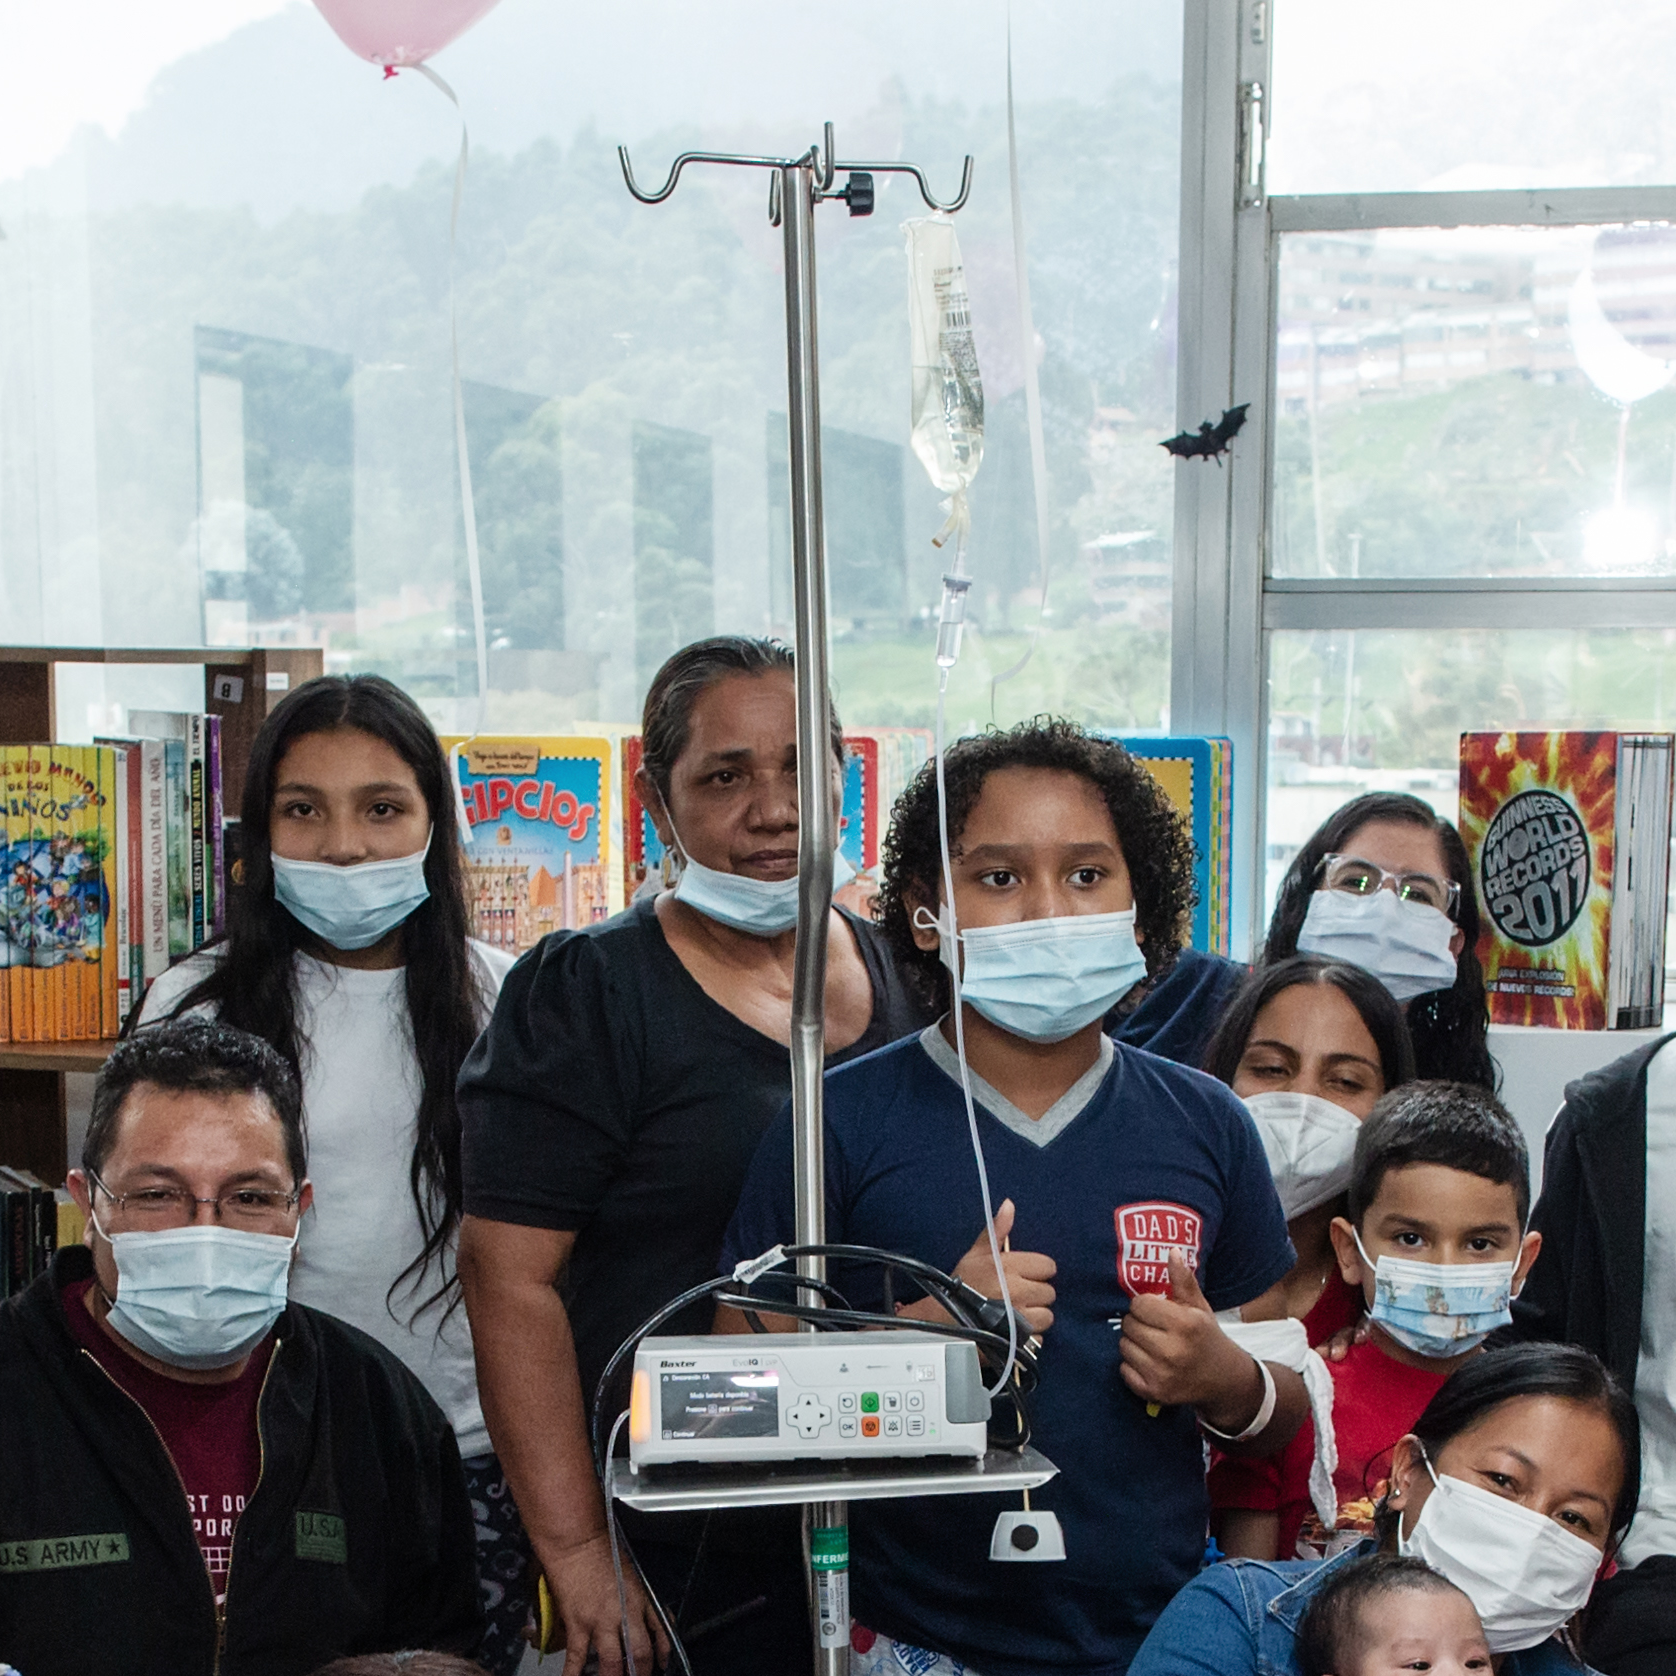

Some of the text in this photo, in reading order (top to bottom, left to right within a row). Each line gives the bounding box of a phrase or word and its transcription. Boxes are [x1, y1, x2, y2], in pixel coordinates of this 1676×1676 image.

[8, 782, 24, 792] DE
[48, 761, 107, 807] MUNDO
[151, 788, 162, 809] DEL
[461, 778, 596, 841] GIPCIOS
[1487, 795, 1569, 850] GUINNESS
[151, 840, 162, 869] CADA
[1485, 814, 1579, 878] WORLD
[1485, 836, 1586, 900] RECORDS
[152, 870, 163, 899] PARA
[1492, 853, 1587, 940] 2011
[1499, 982, 1532, 994] NUEVOS
[1134, 1214, 1193, 1244] DAD'S
[1129, 1243, 1194, 1264] LITE
[1130, 1265, 1170, 1284] CHA
[660, 1359, 697, 1369] Baxter
[842, 1423, 854, 1431] OK
[40, 1540, 101, 1565] ARMY
